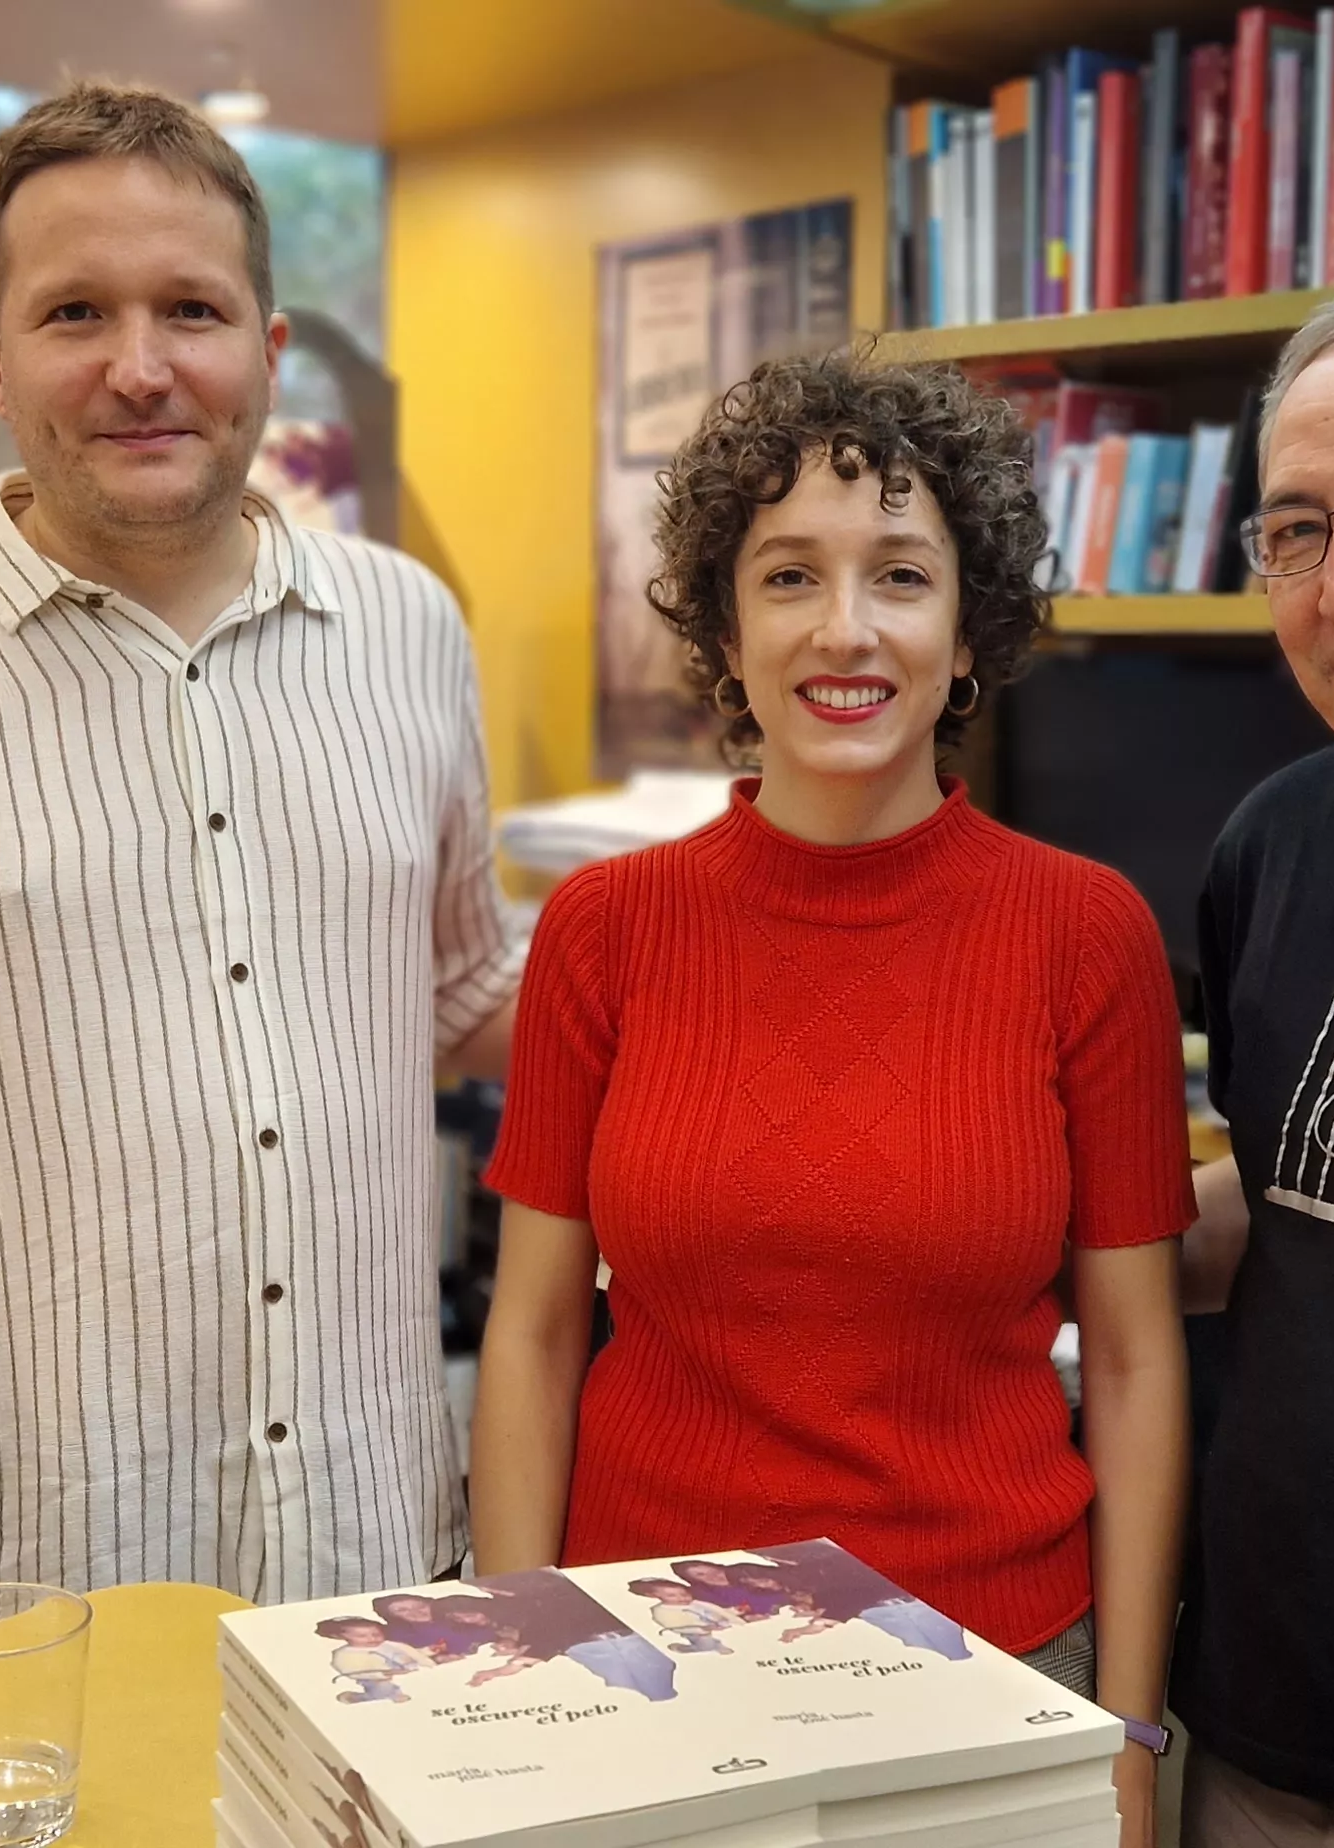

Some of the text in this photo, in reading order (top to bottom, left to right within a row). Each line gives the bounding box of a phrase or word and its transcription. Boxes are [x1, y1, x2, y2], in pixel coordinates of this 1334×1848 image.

[755, 1656, 805, 1668] se te
[776, 1657, 872, 1676] oscurece
[852, 1660, 923, 1678] el pelo
[430, 1702, 487, 1718] se te
[451, 1702, 563, 1726] oscurece
[536, 1702, 619, 1726] el pelo
